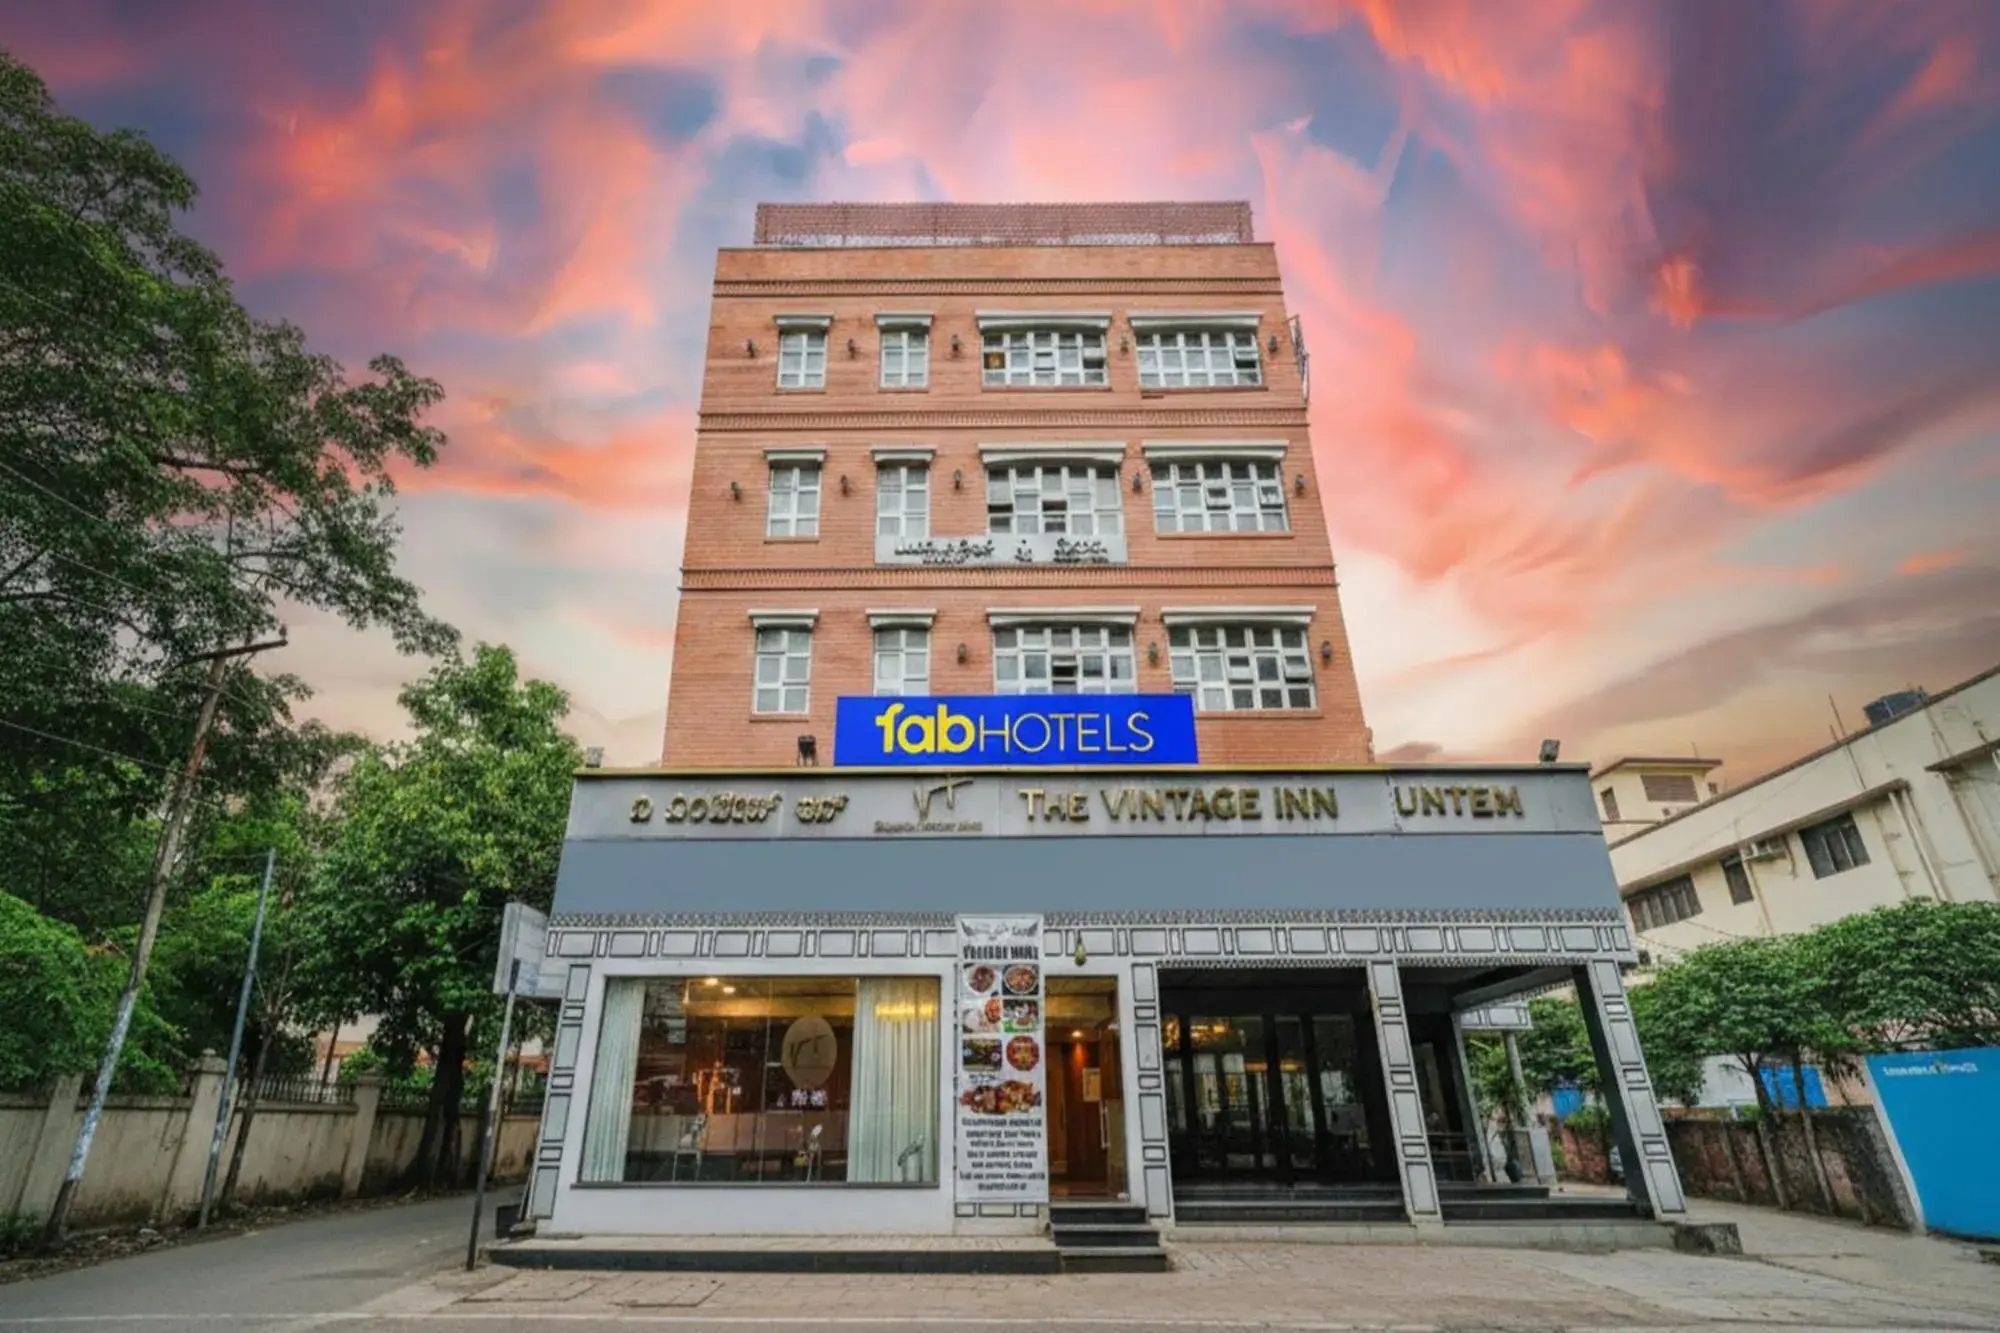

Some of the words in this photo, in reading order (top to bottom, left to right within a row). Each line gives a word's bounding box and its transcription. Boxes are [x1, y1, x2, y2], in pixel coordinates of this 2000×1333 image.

[1018, 788, 1089, 822] THE
[1100, 786, 1262, 821] VINTAGE
[1274, 785, 1339, 820] INN
